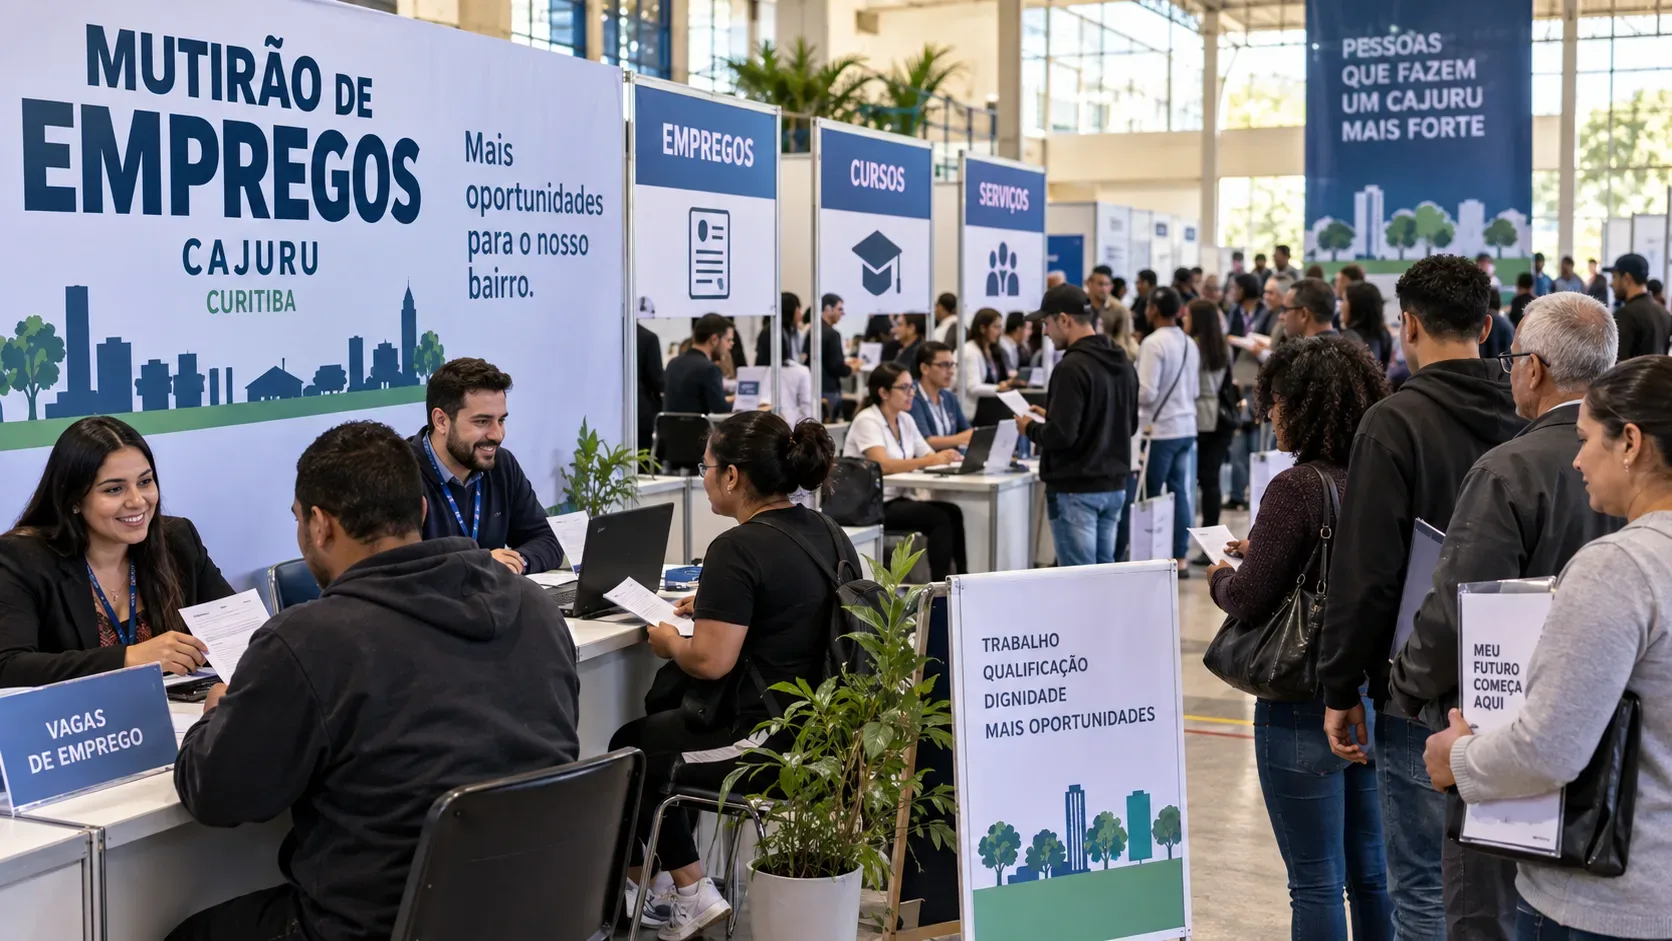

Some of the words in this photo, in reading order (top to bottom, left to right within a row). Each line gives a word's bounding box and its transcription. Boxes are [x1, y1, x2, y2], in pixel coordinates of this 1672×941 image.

[1342, 32, 1443, 58] PESSOAS
[86, 24, 322, 112] MUTIRÃO
[335, 72, 373, 119] DE
[1342, 64, 1391, 89] QUE
[1397, 58, 1477, 83] FAZEM
[1342, 91, 1380, 114] UM
[1386, 86, 1484, 111] CAJURU
[1342, 118, 1401, 142] MAIS
[1407, 115, 1486, 139] FORTE
[22, 97, 422, 225] EMPREGOS
[465, 130, 514, 167] Mais
[662, 122, 755, 168] EMPREGOS
[850, 159, 905, 193] CURSOS
[465, 182, 604, 217] oportunidades
[979, 181, 1030, 214] SERVIÇOS
[182, 237, 318, 276] CAJURU
[467, 229, 513, 262] para
[519, 232, 531, 256] o
[537, 231, 589, 256] nosso
[468, 266, 534, 300] bairro.
[206, 289, 297, 315] CURITIBA
[981, 632, 1060, 653] TRABALHO
[1473, 643, 1500, 657] MEU
[983, 654, 1089, 681] QUALIFICAÇÃO
[1473, 660, 1520, 676] FUTURO
[984, 686, 1067, 710] DIGNIDADE
[1473, 677, 1523, 694] COMEÇA
[1473, 695, 1504, 710] AQUI
[45, 708, 107, 740] VAGAS
[985, 719, 1025, 739] MAIS
[1029, 706, 1156, 735] OPORTUNIDADES
[28, 750, 55, 774] DE
[57, 727, 144, 767] EMPREGO
